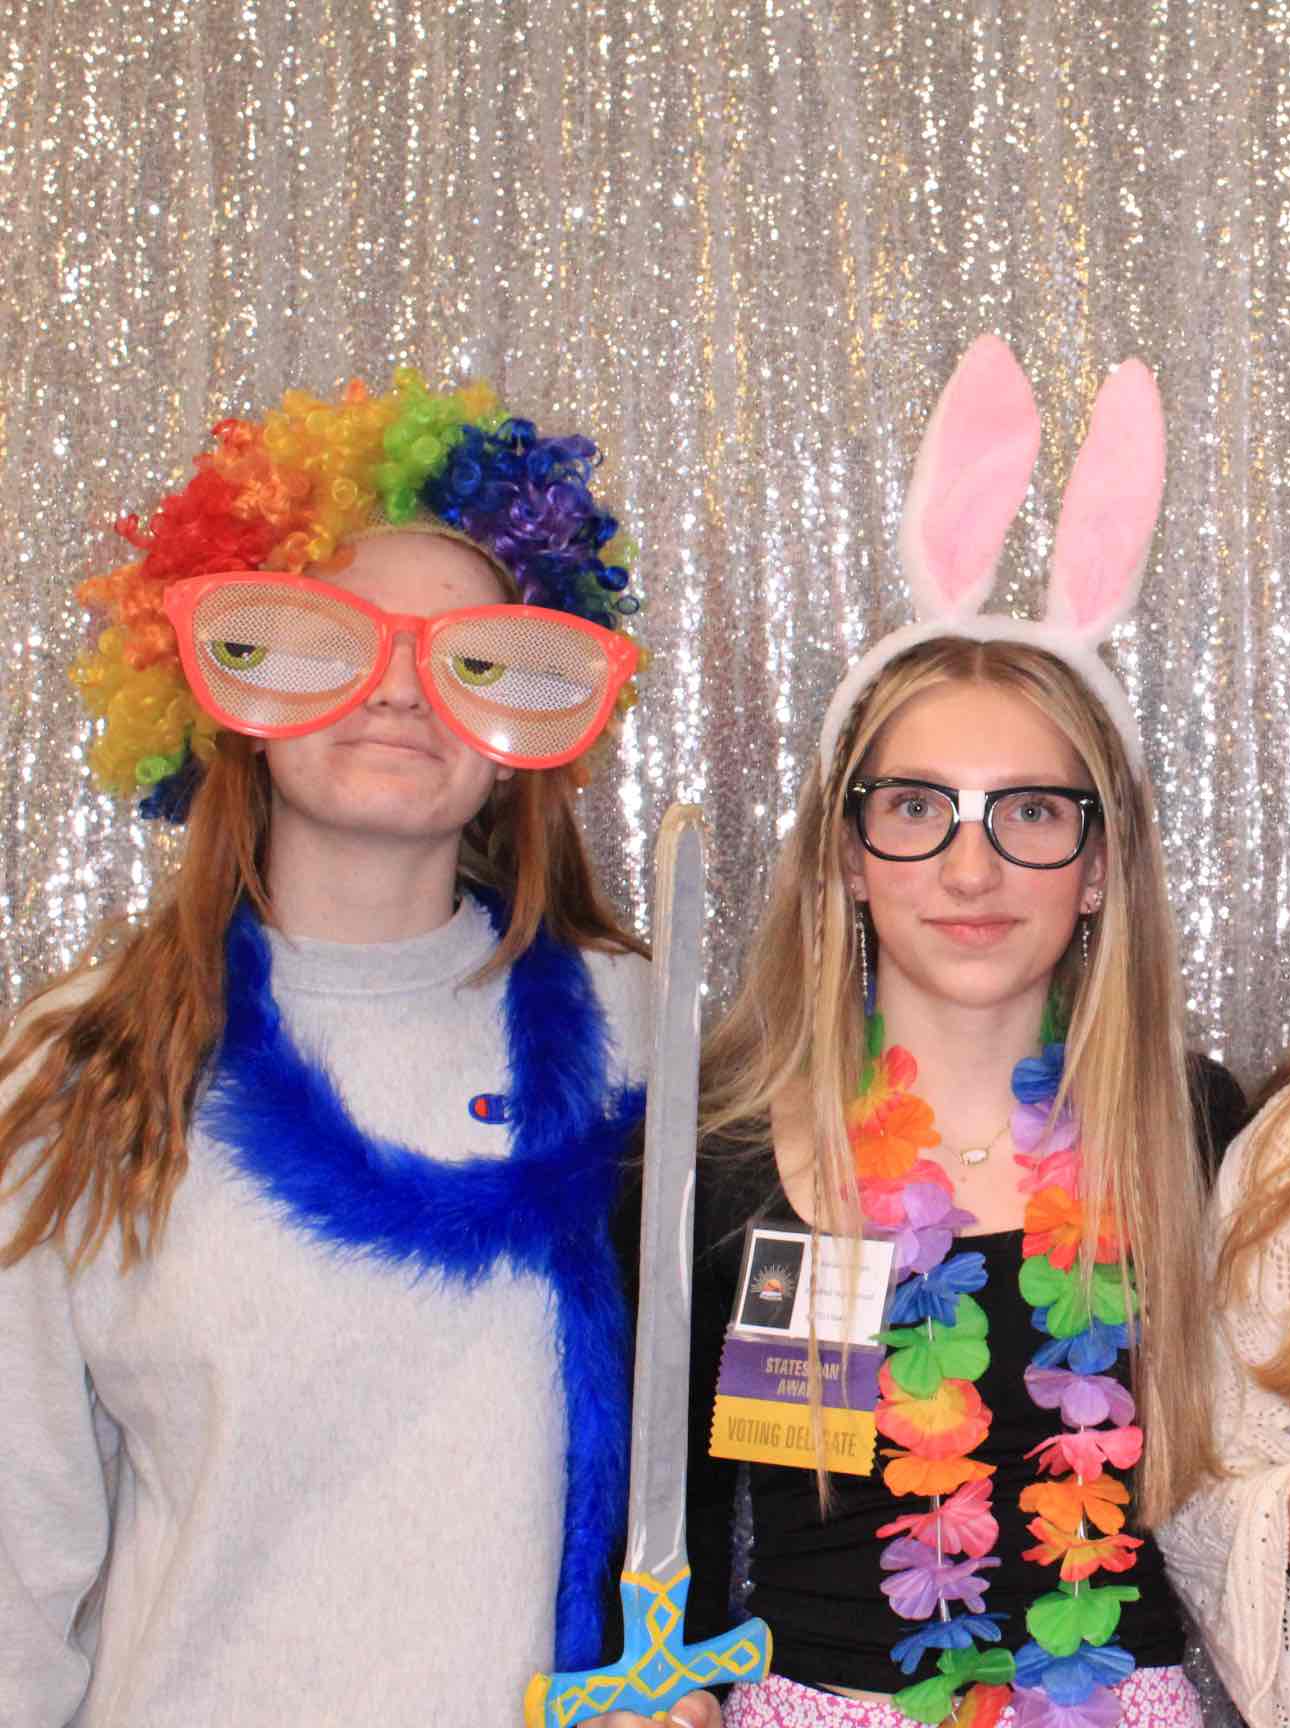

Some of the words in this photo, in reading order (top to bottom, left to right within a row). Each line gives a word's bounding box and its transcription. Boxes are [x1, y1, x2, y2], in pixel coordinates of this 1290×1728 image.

[766, 1357, 839, 1380] STATESAN
[777, 1378, 816, 1398] AWA
[727, 1415, 781, 1448] VOTING
[785, 1424, 856, 1457] DELGATE
